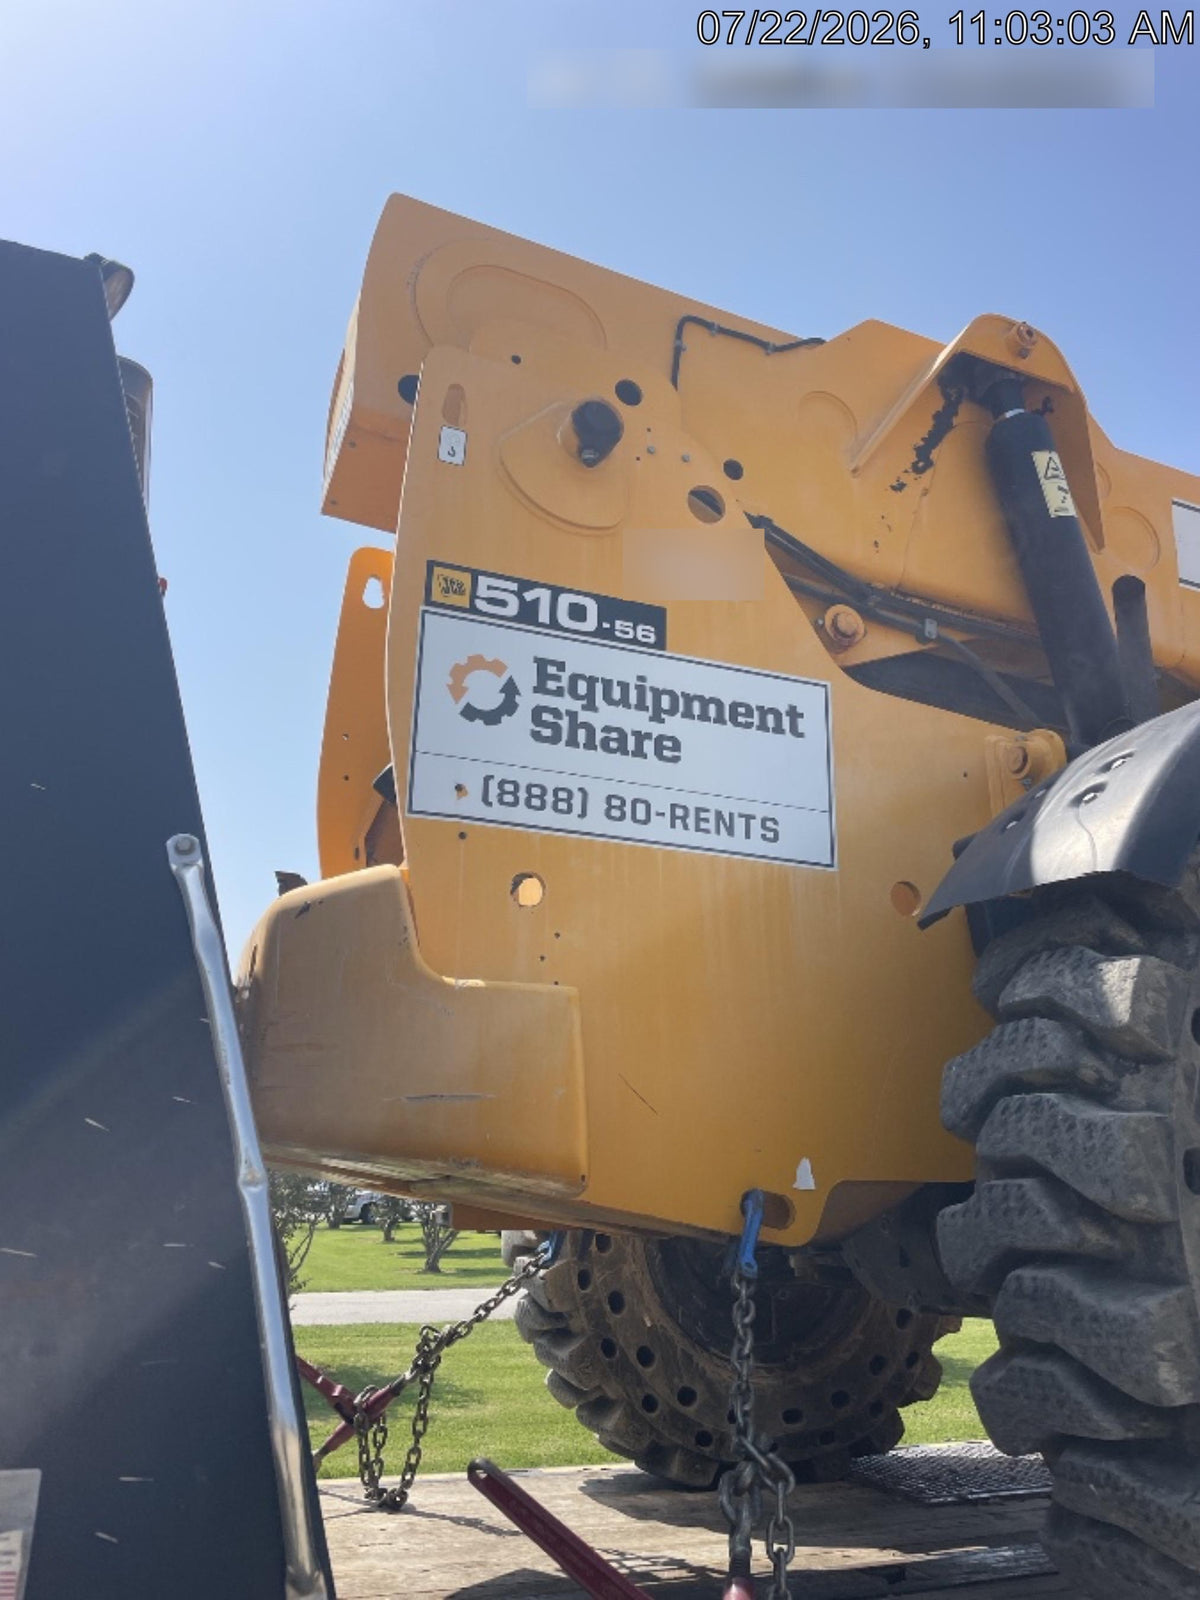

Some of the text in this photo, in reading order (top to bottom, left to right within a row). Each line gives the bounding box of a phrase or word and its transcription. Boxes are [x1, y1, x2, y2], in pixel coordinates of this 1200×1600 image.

[533, 656, 805, 738] Equipment
[530, 705, 682, 763] Share
[481, 775, 780, 843] (888) 80-RENTS
